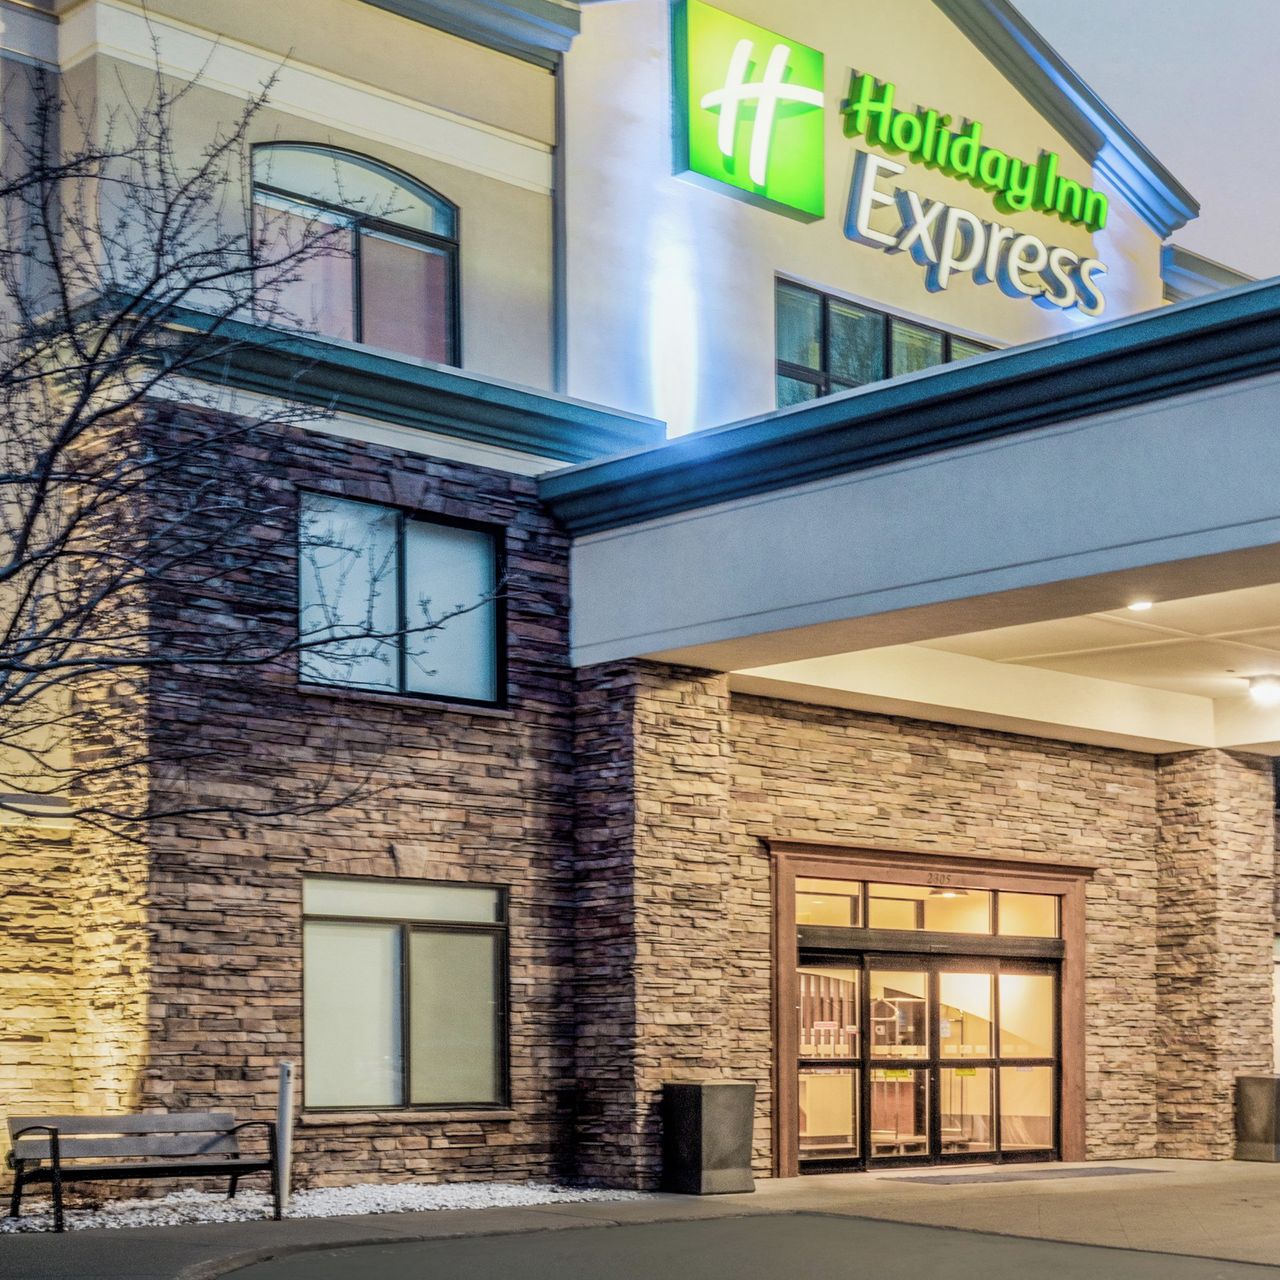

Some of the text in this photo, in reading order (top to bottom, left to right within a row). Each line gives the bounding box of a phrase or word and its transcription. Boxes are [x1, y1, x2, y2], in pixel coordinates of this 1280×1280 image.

[840, 70, 1109, 232] Holiday Inn
[846, 152, 1109, 317] Express
